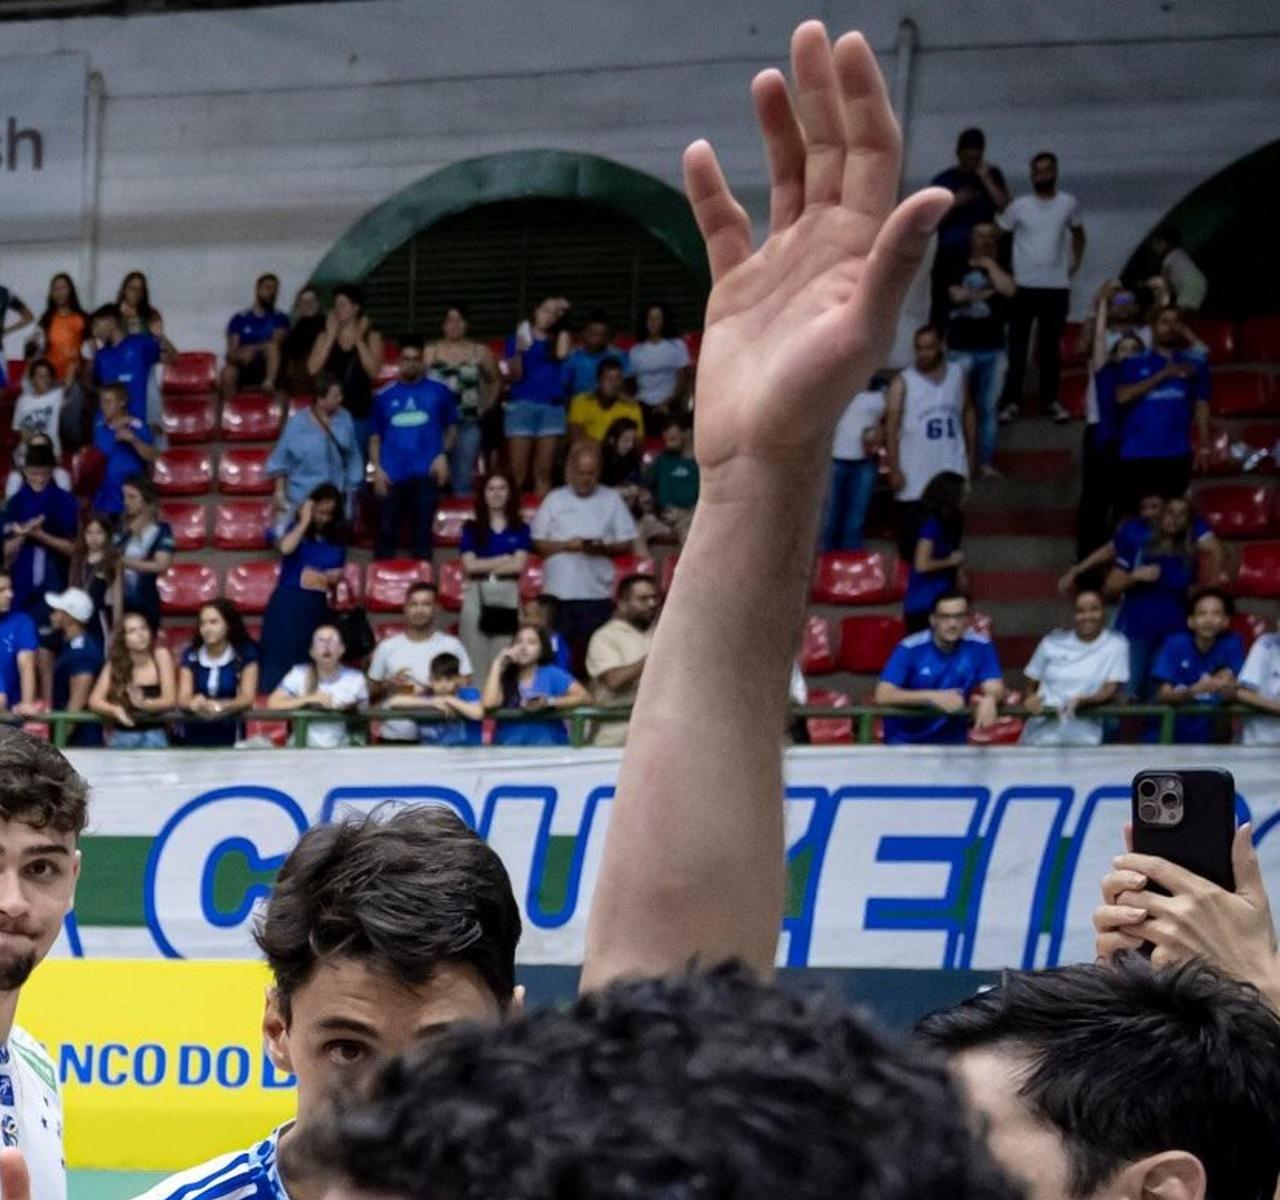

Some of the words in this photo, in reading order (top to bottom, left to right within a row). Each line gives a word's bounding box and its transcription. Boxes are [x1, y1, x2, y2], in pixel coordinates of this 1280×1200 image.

[926, 417, 957, 439] 61
[59, 1043, 167, 1087] NCO
[178, 1045, 251, 1089] DO
